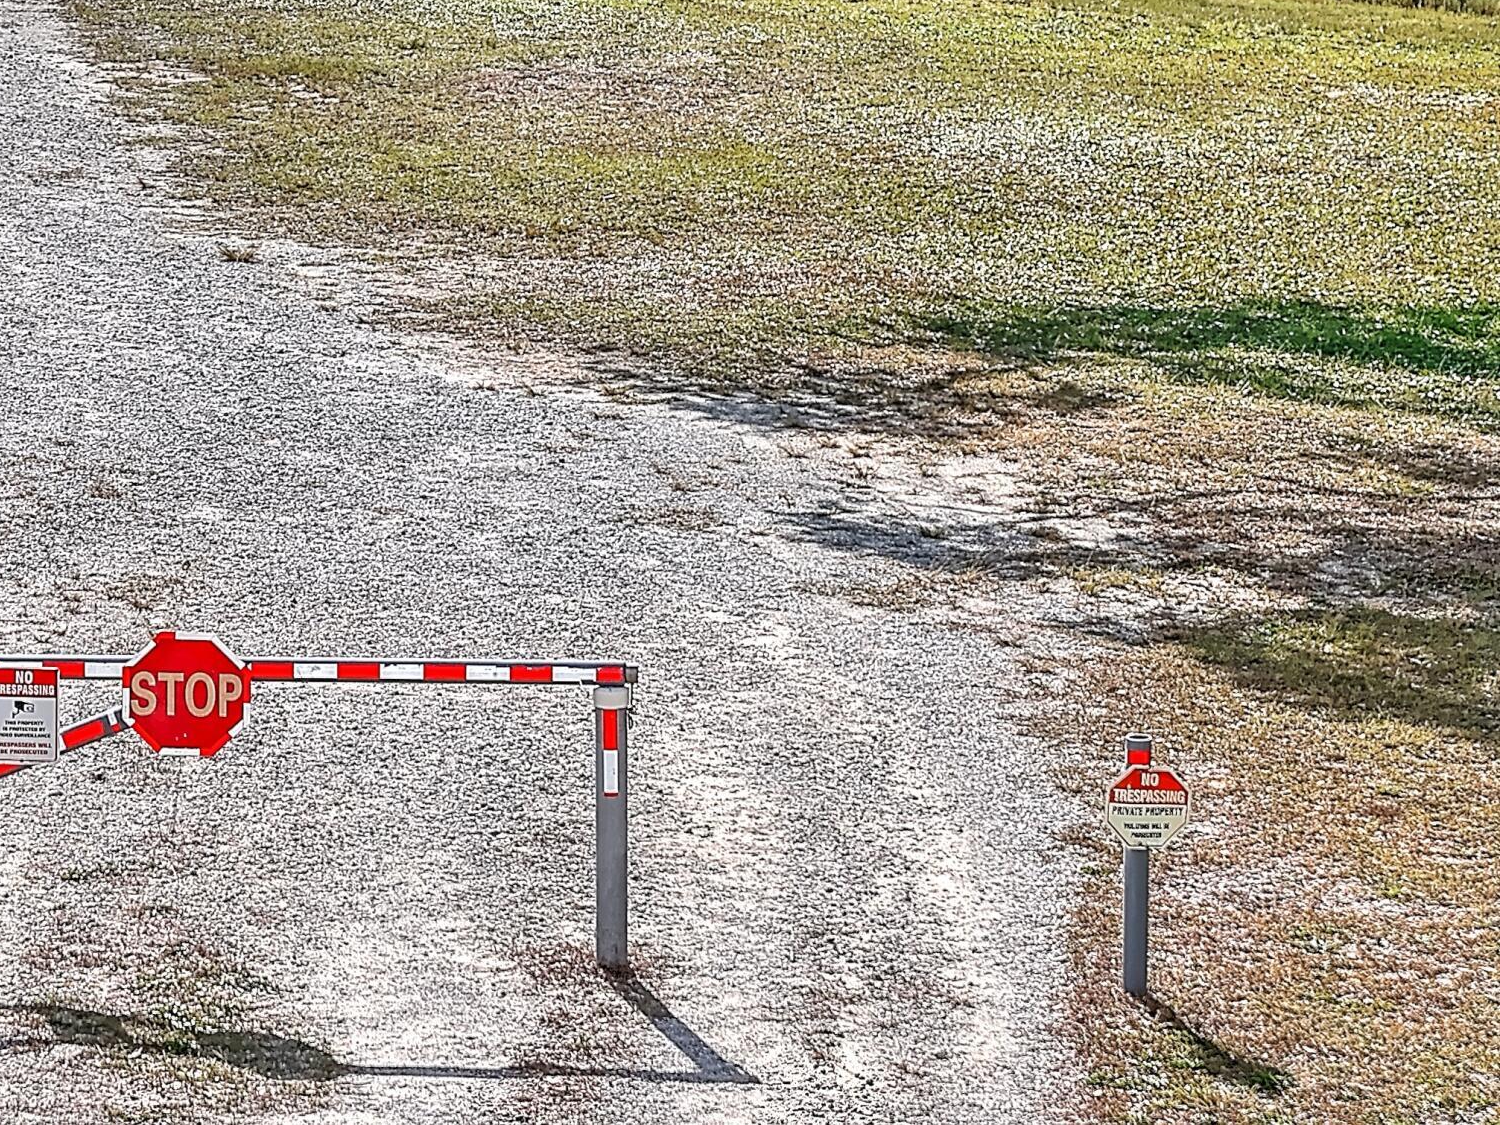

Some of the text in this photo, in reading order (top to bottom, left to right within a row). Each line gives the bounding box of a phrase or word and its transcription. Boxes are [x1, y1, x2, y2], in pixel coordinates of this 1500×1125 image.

[15, 670, 34, 684] NO
[131, 671, 243, 718] STOP
[1141, 773, 1159, 786] NO
[1113, 789, 1185, 803] TRESPASSING
[1112, 806, 1183, 815] PRIVATE PROPERTY
